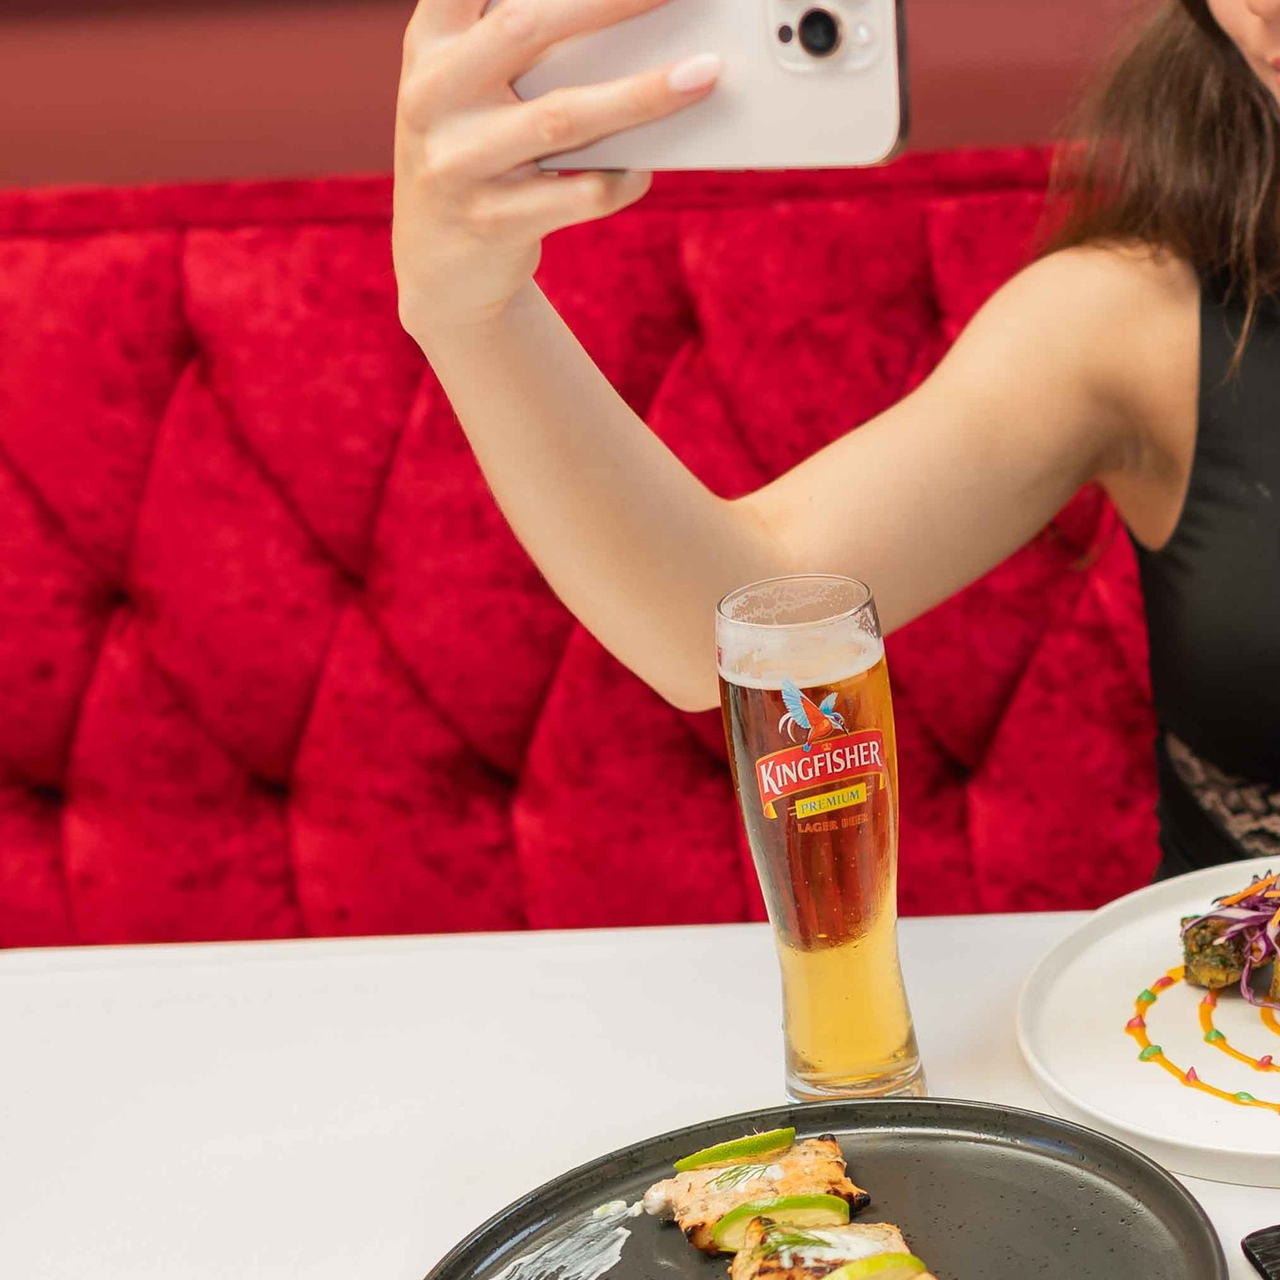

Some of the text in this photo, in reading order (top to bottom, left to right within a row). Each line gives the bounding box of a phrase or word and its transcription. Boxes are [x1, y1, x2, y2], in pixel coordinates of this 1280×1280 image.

[760, 741, 882, 795] KINGFISHER
[801, 790, 860, 814] PREMIUM
[797, 820, 838, 833] LAGER
